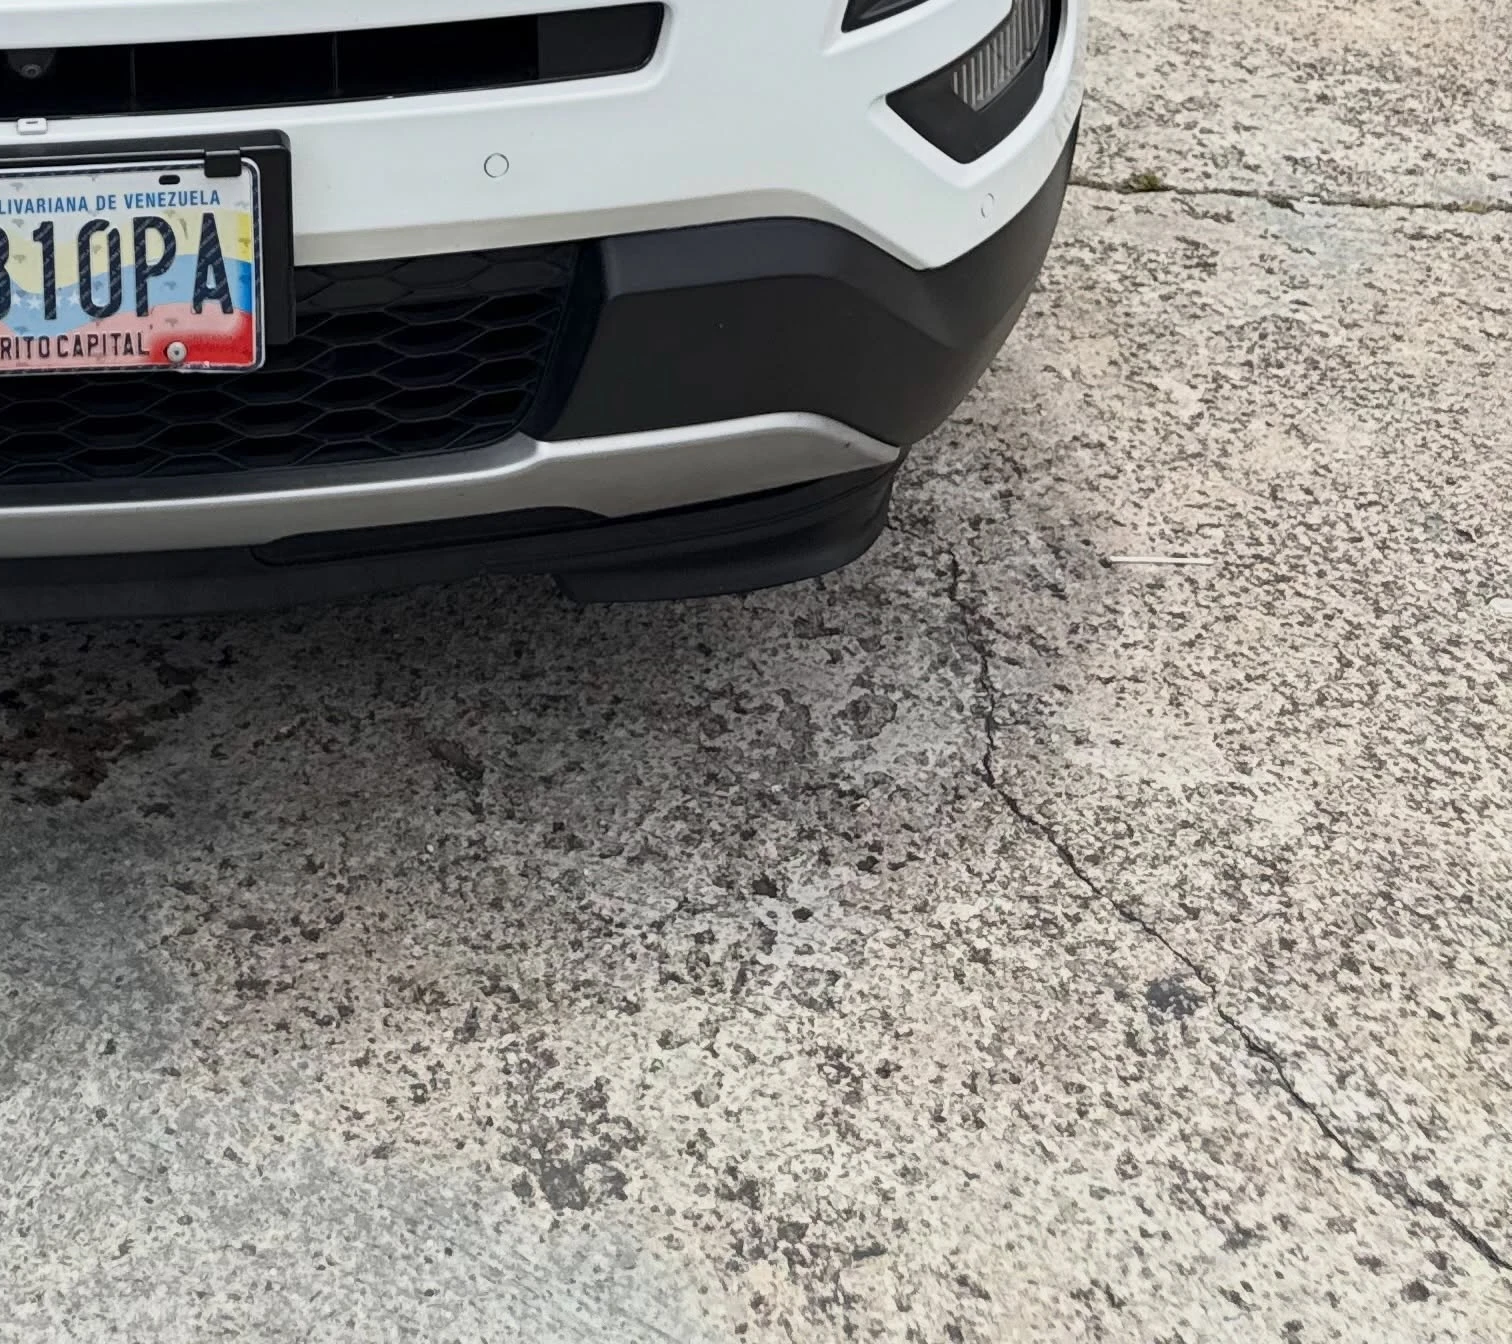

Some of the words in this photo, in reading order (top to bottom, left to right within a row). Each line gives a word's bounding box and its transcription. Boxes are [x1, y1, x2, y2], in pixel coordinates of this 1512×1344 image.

[95, 194, 118, 211] DE
[124, 189, 221, 209] VENEZUELA
[56, 331, 150, 359] CAPITAL
